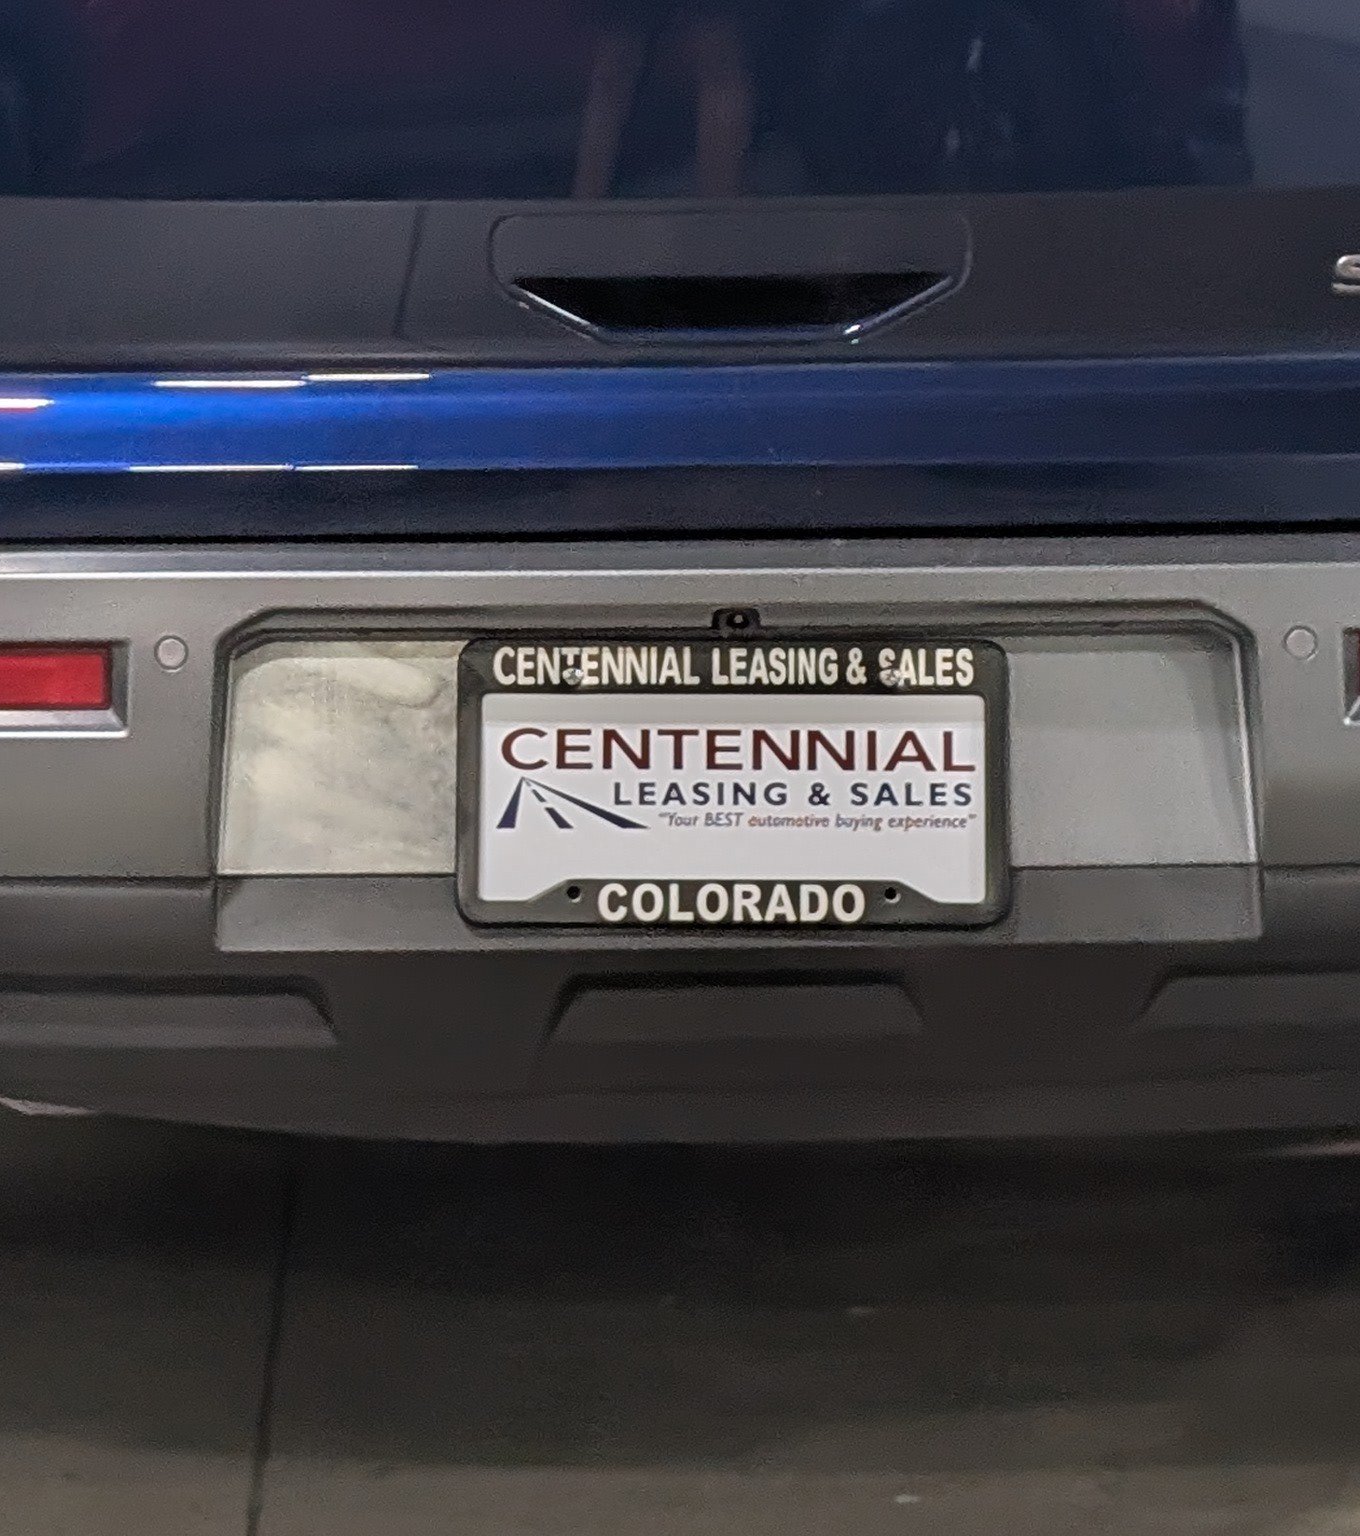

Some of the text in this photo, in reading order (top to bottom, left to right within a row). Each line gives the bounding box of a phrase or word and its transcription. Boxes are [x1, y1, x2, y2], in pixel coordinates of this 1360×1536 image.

[493, 646, 701, 686] CENTENNIAL
[711, 647, 839, 686] LEASING
[845, 647, 868, 686] &
[500, 727, 977, 773] CENTENNIAL
[613, 781, 973, 807] LEASING & SALES
[703, 811, 744, 828] BEST
[747, 813, 830, 828] automotive
[834, 813, 883, 832] buying
[597, 882, 866, 923] COLORADO
